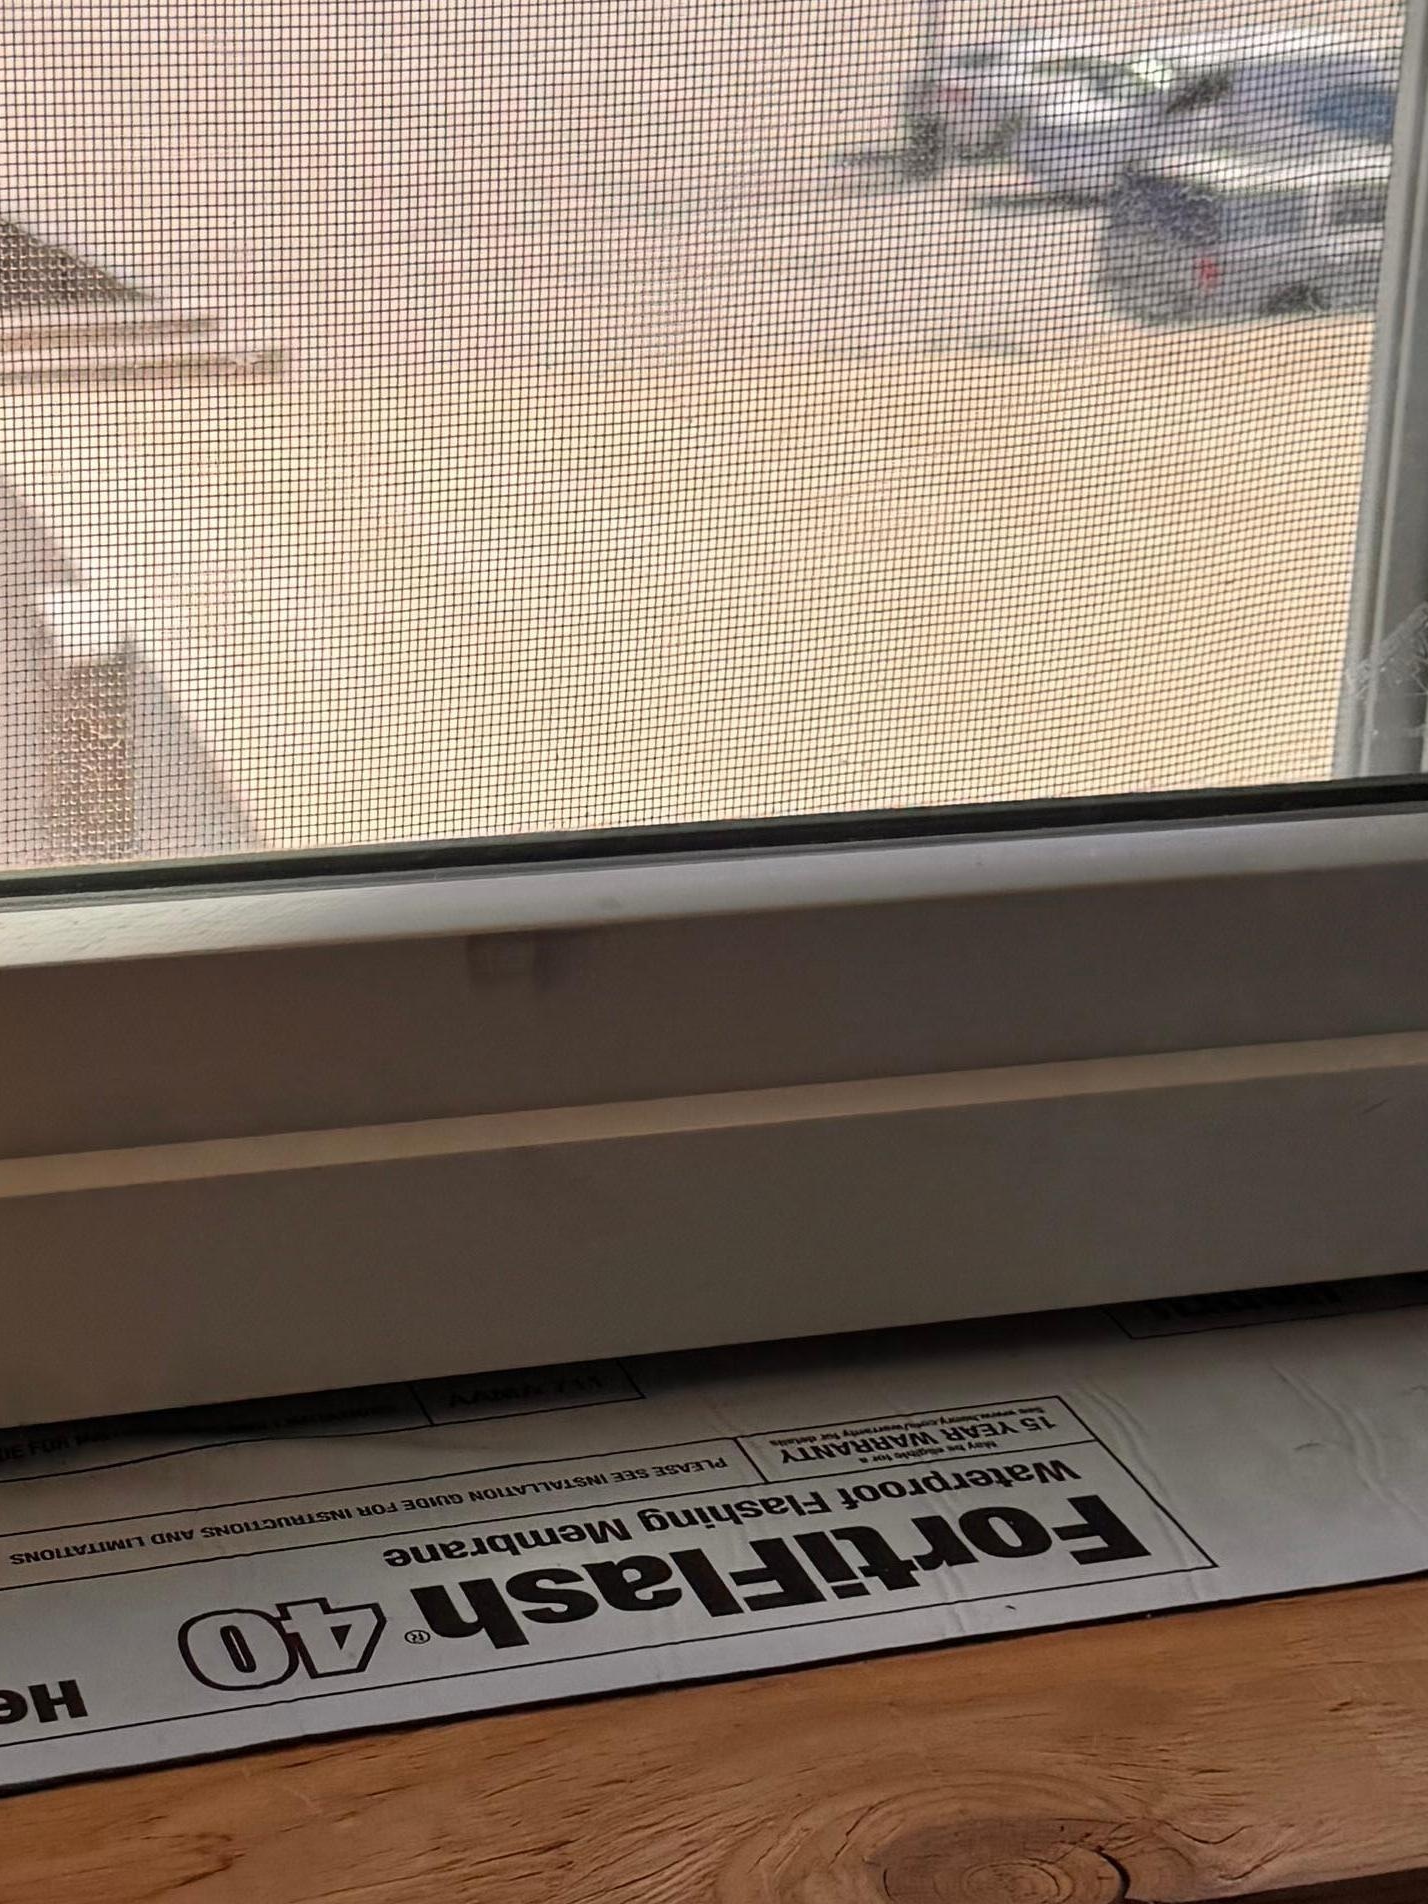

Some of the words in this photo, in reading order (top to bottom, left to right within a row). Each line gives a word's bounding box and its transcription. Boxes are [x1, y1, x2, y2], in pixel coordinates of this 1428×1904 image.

[941, 1420, 1018, 1442] YEAR
[1019, 1414, 1055, 1432] 15
[778, 1430, 936, 1463] WARRANTY
[608, 1465, 648, 1484] SEE
[651, 1455, 726, 1478] PLEASE
[467, 1471, 607, 1501] INSTALLATION
[835, 1457, 1080, 1509] Waterproof
[355, 1500, 397, 1518] FOR
[400, 1491, 464, 1512] GUIDE
[637, 1489, 831, 1532] Flashing
[149, 1526, 194, 1546] AND
[199, 1507, 352, 1539] INSTRUCTIONS
[7, 1533, 144, 1565] LIMITATIONS
[382, 1516, 631, 1569] Membrane
[176, 1595, 386, 1691] 40
